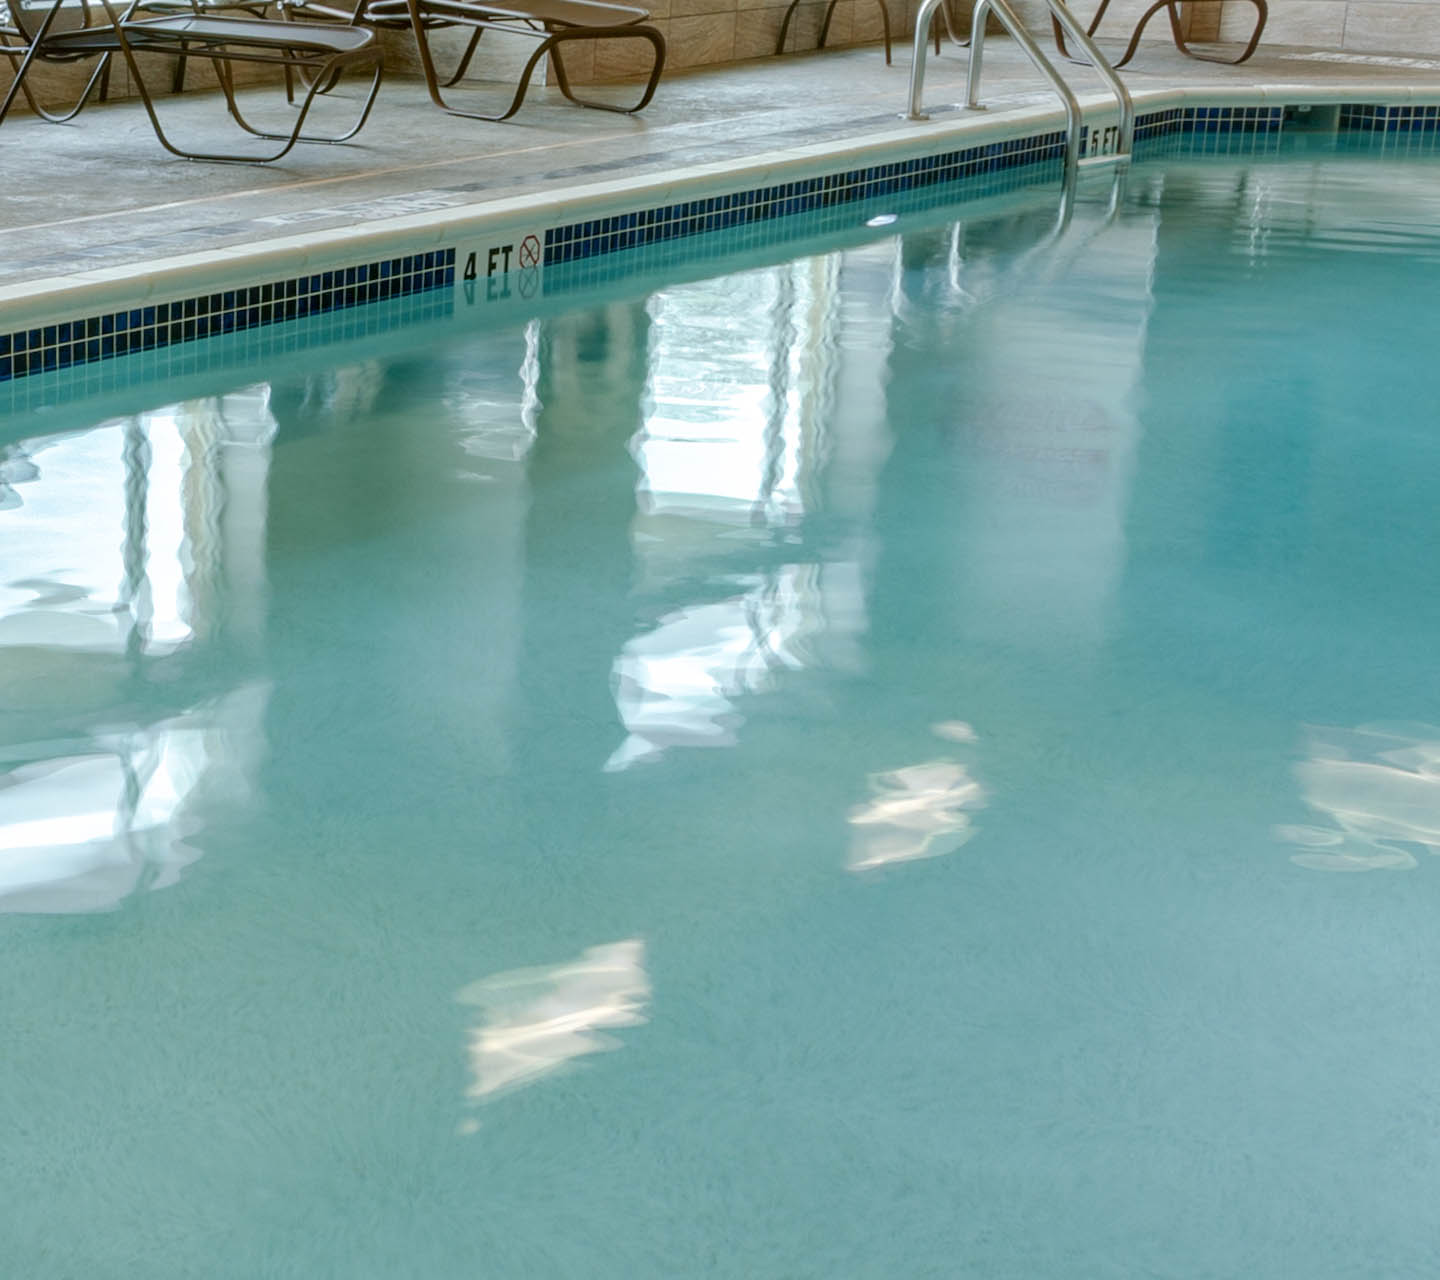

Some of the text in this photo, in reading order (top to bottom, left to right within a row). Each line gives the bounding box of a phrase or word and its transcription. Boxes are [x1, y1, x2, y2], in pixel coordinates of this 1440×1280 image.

[1090, 126, 1118, 156] 5 FT
[463, 244, 513, 281] 4 FT
